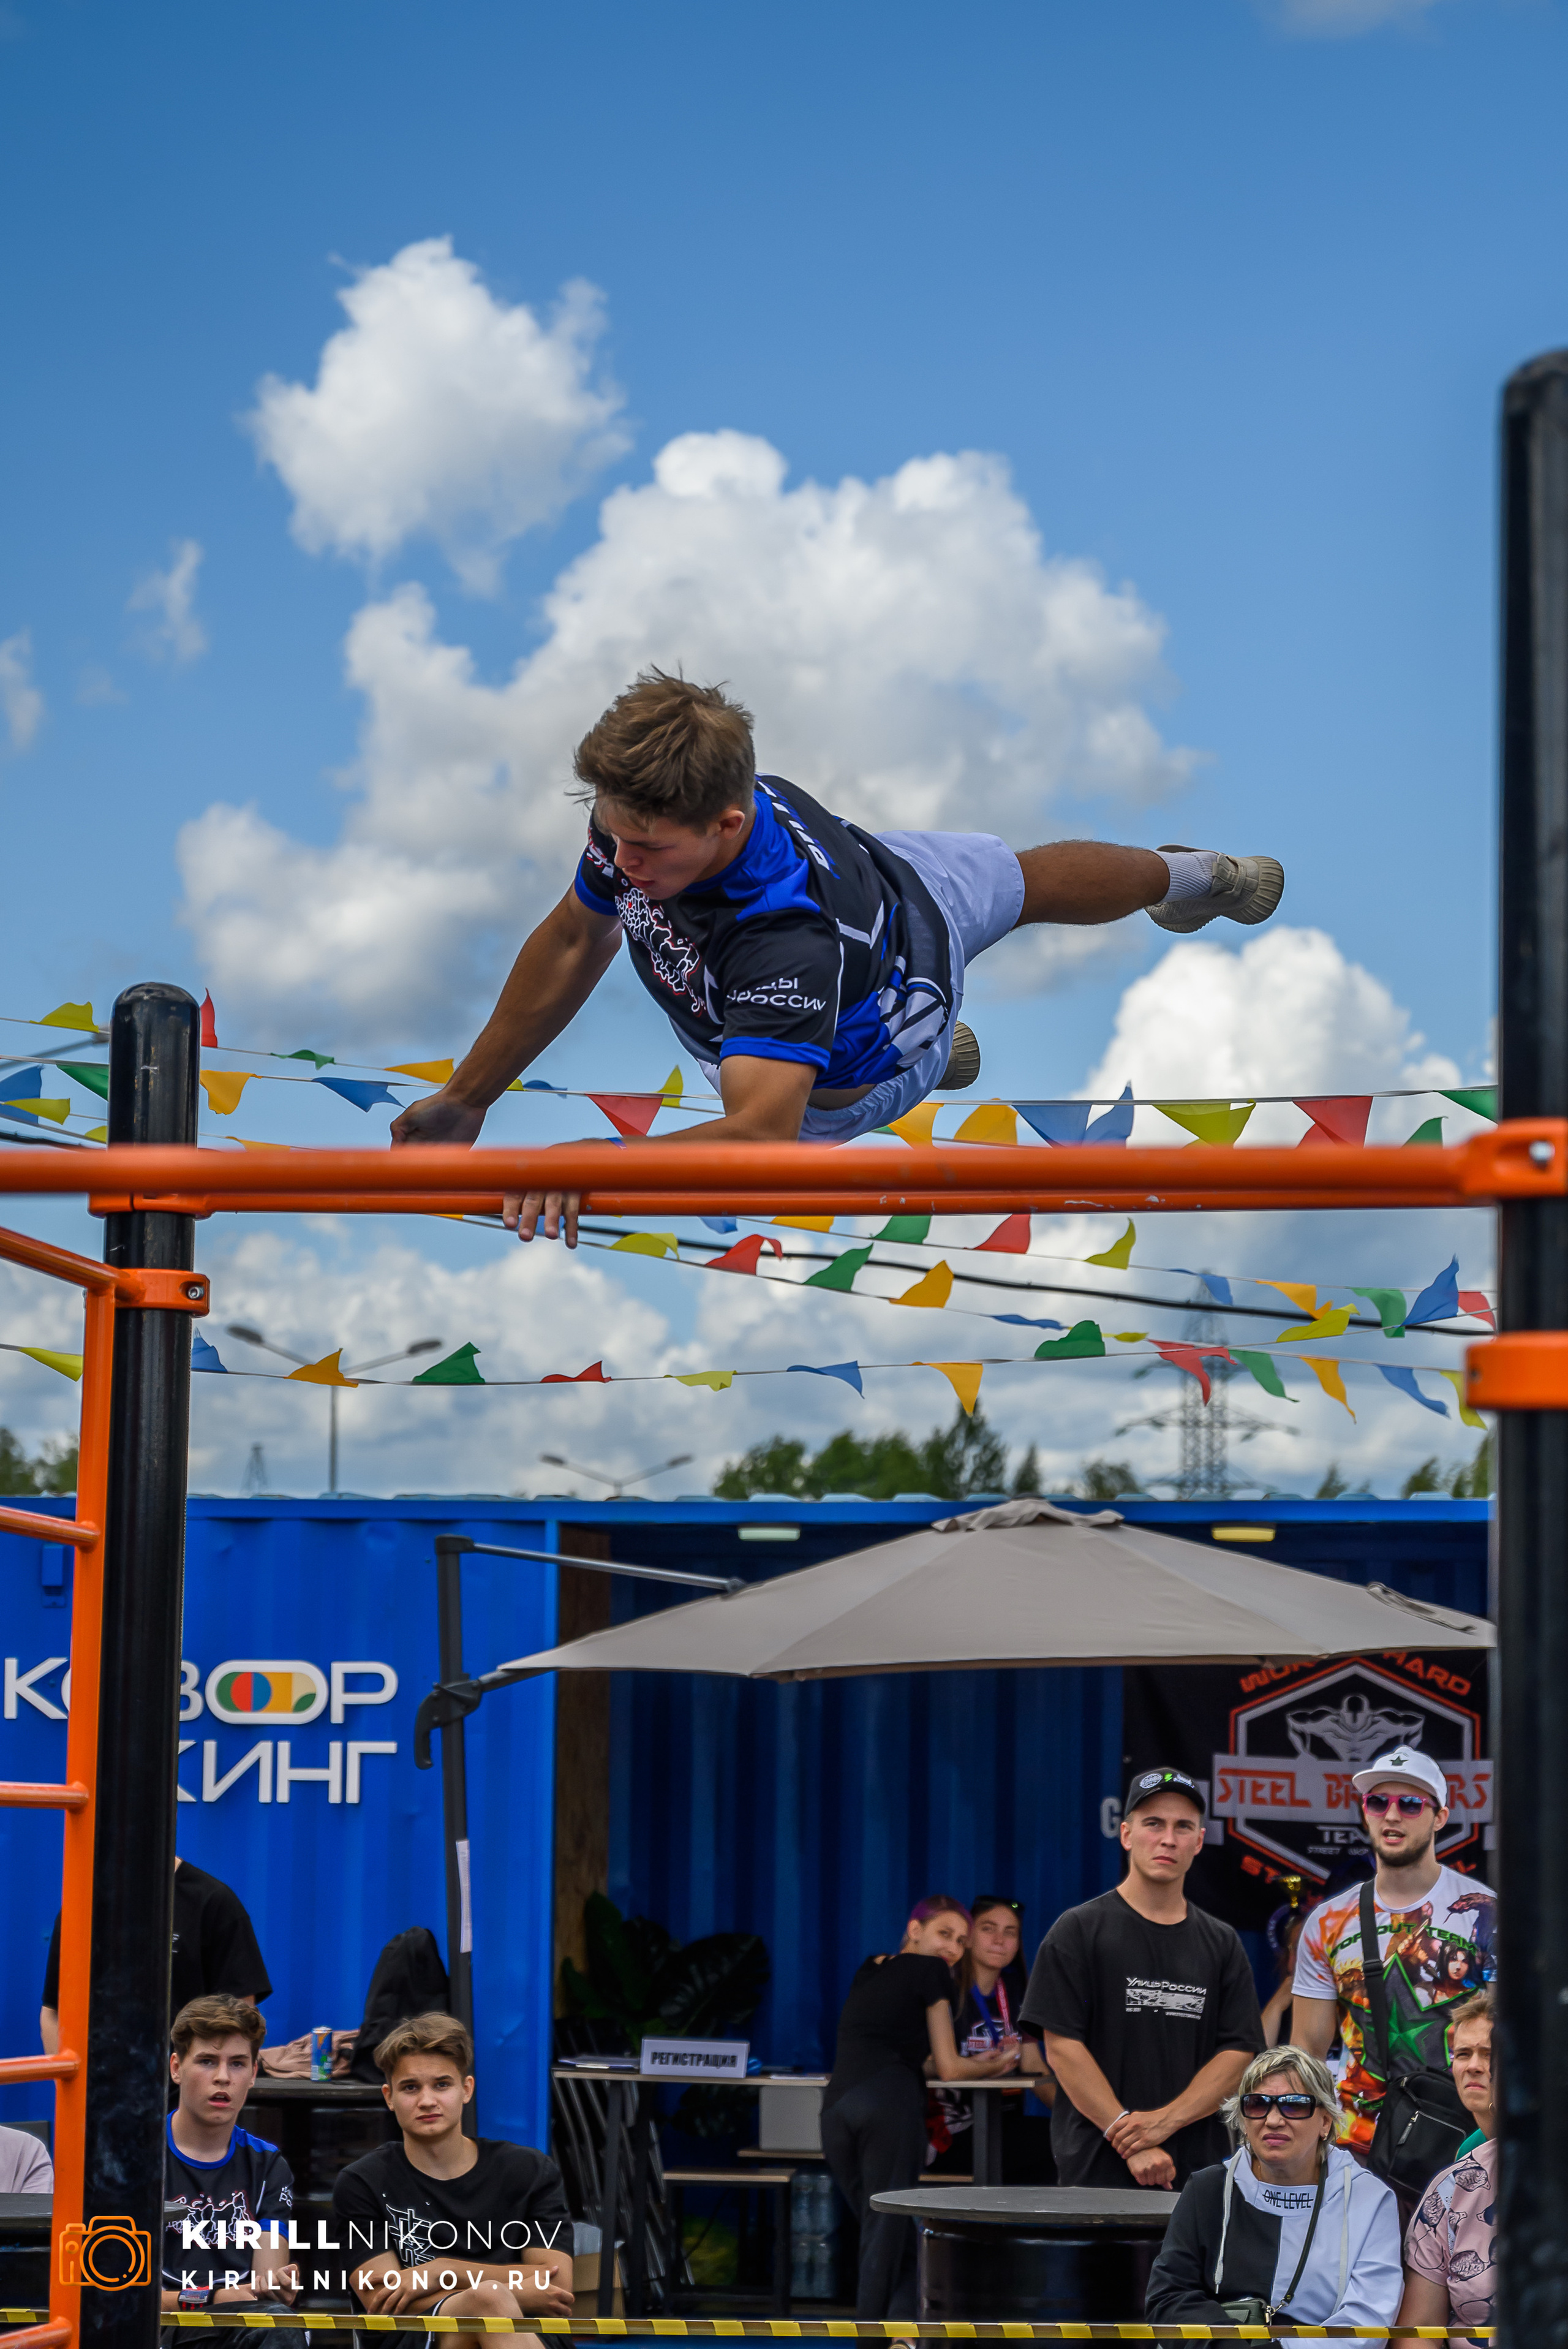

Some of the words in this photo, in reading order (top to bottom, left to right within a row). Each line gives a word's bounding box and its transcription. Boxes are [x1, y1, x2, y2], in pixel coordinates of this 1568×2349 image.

[1217, 1768, 1311, 1808] STEEL
[1316, 1825, 1371, 1844] TEA
[651, 2051, 738, 2069] РЕГИСТРАЦИЯ
[1263, 2189, 1281, 2208] ONE
[1284, 2192, 1312, 2210] LEVEL
